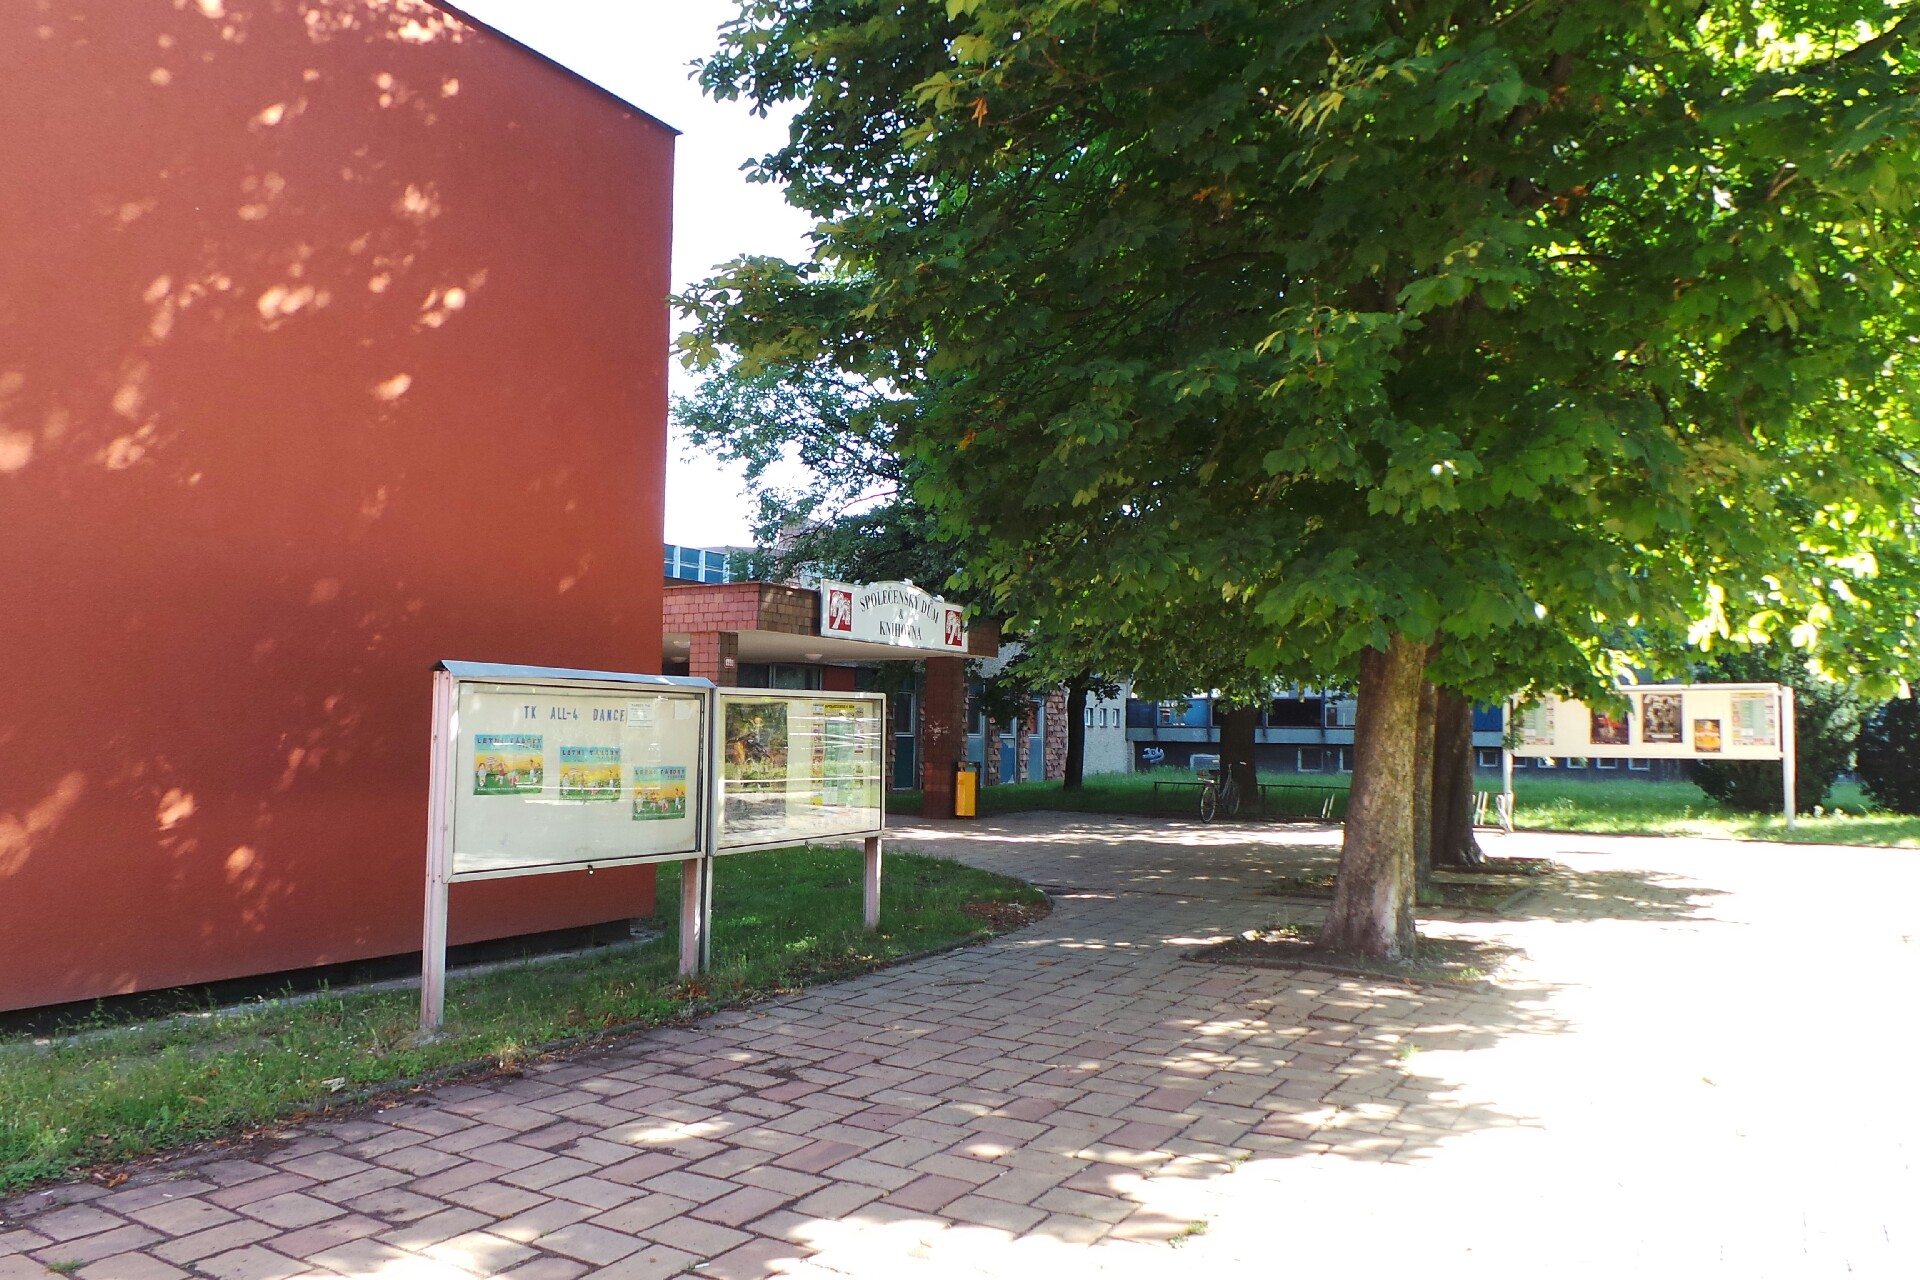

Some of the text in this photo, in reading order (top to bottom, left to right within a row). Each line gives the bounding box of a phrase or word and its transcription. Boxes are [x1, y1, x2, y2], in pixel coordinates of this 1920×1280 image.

[860, 585, 940, 623] SPOLEČENSKÝ DŮM
[898, 608, 904, 619] &
[879, 620, 922, 641] KNIHOVNA
[523, 705, 537, 719] TK
[550, 706, 579, 720] ALL-4
[592, 708, 626, 722] DANCE
